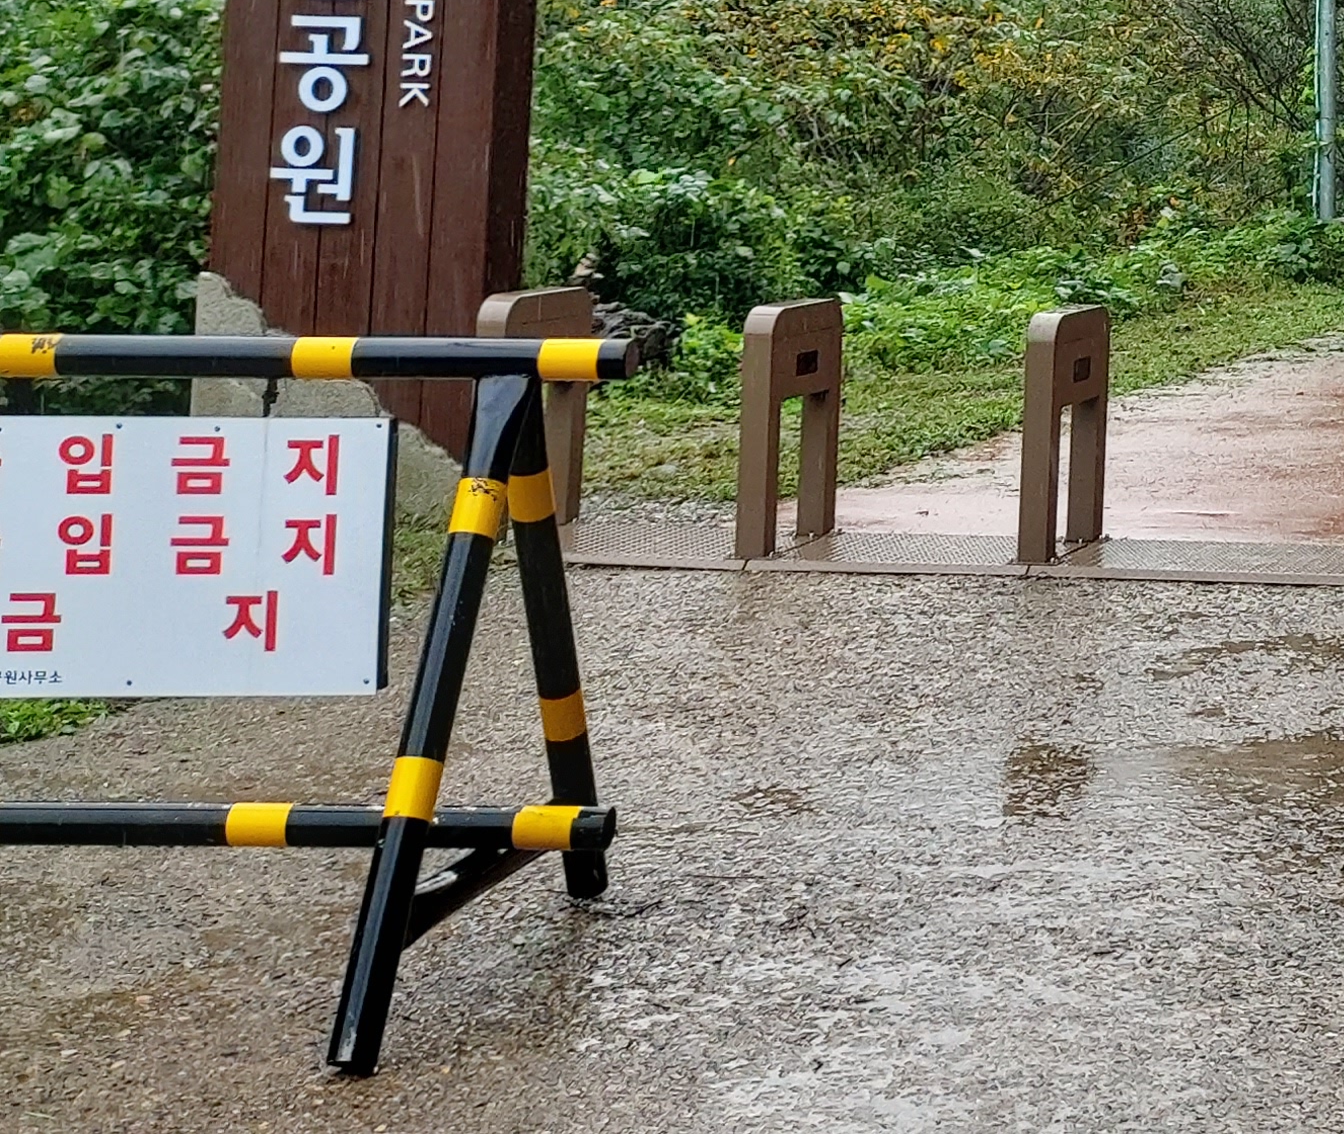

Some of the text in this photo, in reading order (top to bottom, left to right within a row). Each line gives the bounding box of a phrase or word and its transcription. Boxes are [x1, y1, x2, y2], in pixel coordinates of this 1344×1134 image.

[0, 590, 280, 653] 금 지
[0, 669, 63, 686] 원사무소
